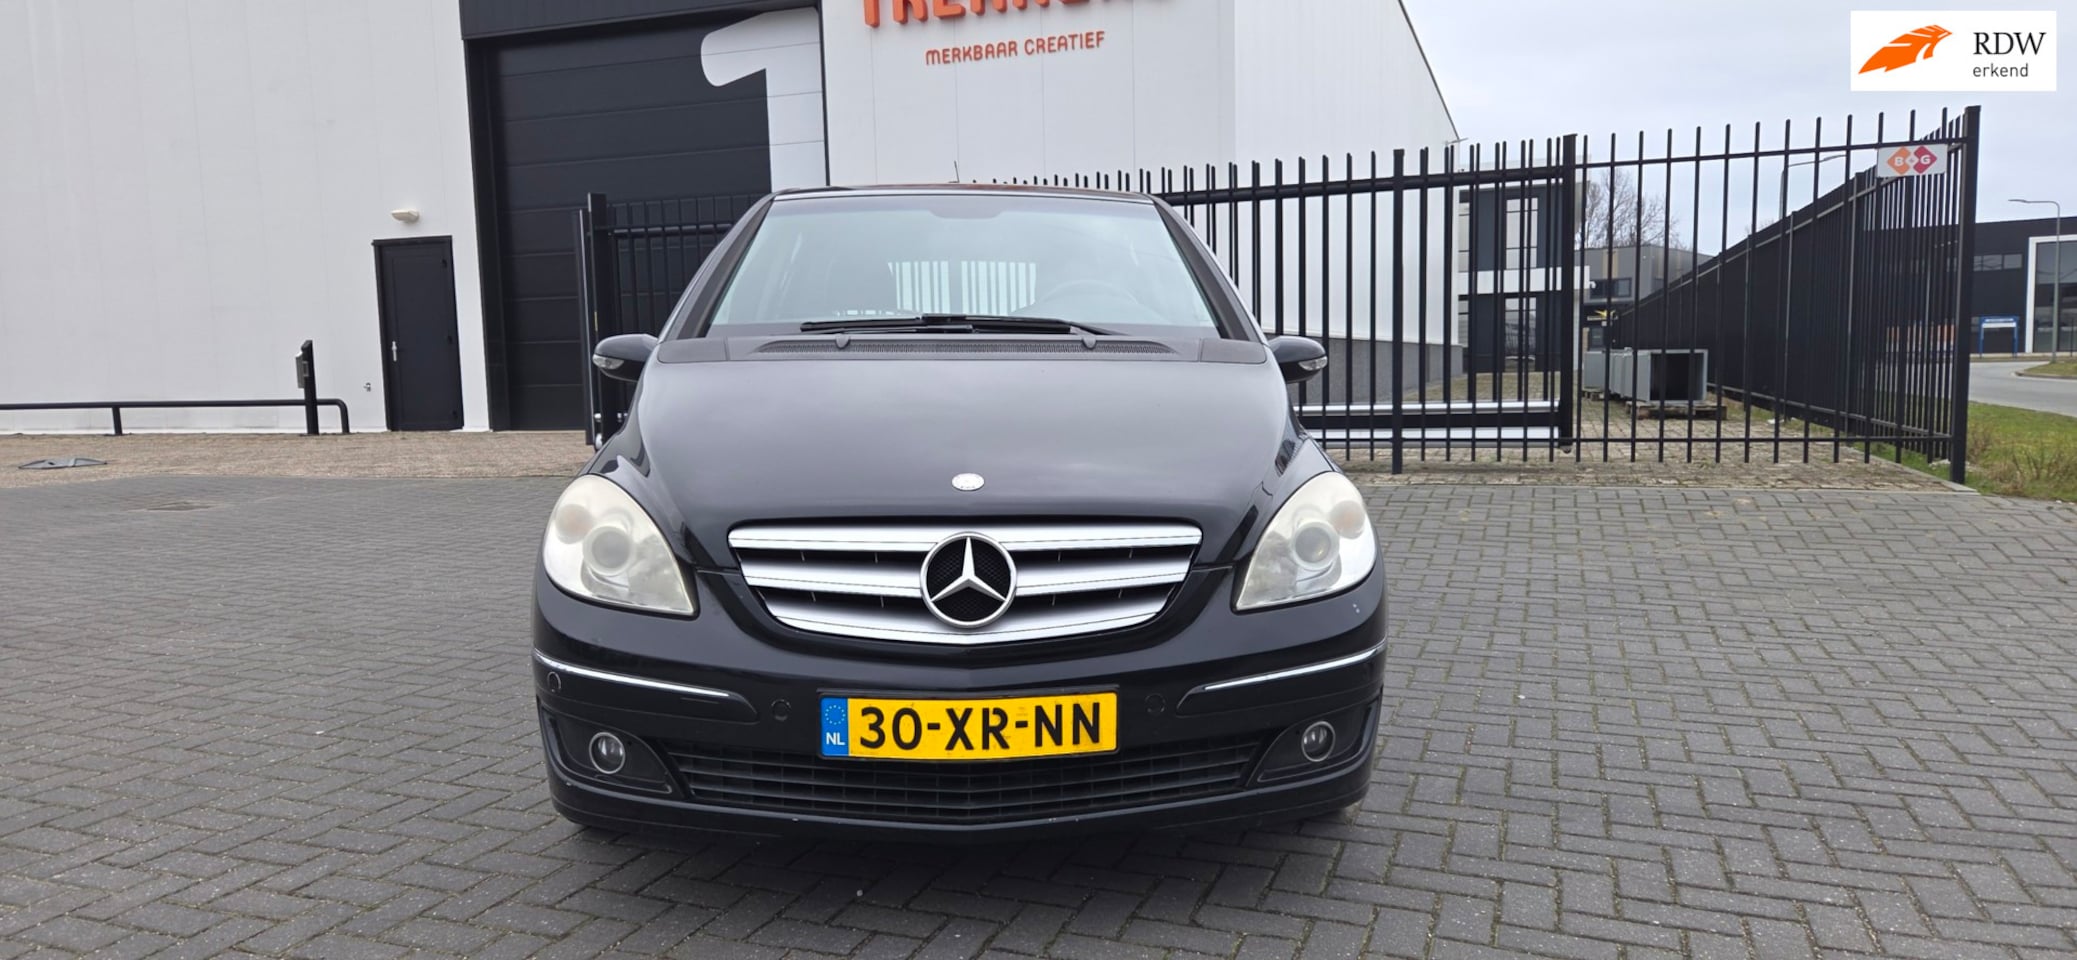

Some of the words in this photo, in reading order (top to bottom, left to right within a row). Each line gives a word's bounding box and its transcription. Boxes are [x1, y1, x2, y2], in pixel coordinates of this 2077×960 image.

[925, 40, 1018, 65] MERKBAAR
[1023, 30, 1105, 55] CREATIEF
[826, 732, 845, 746] NL
[860, 702, 1101, 751] 30-XR-NN
